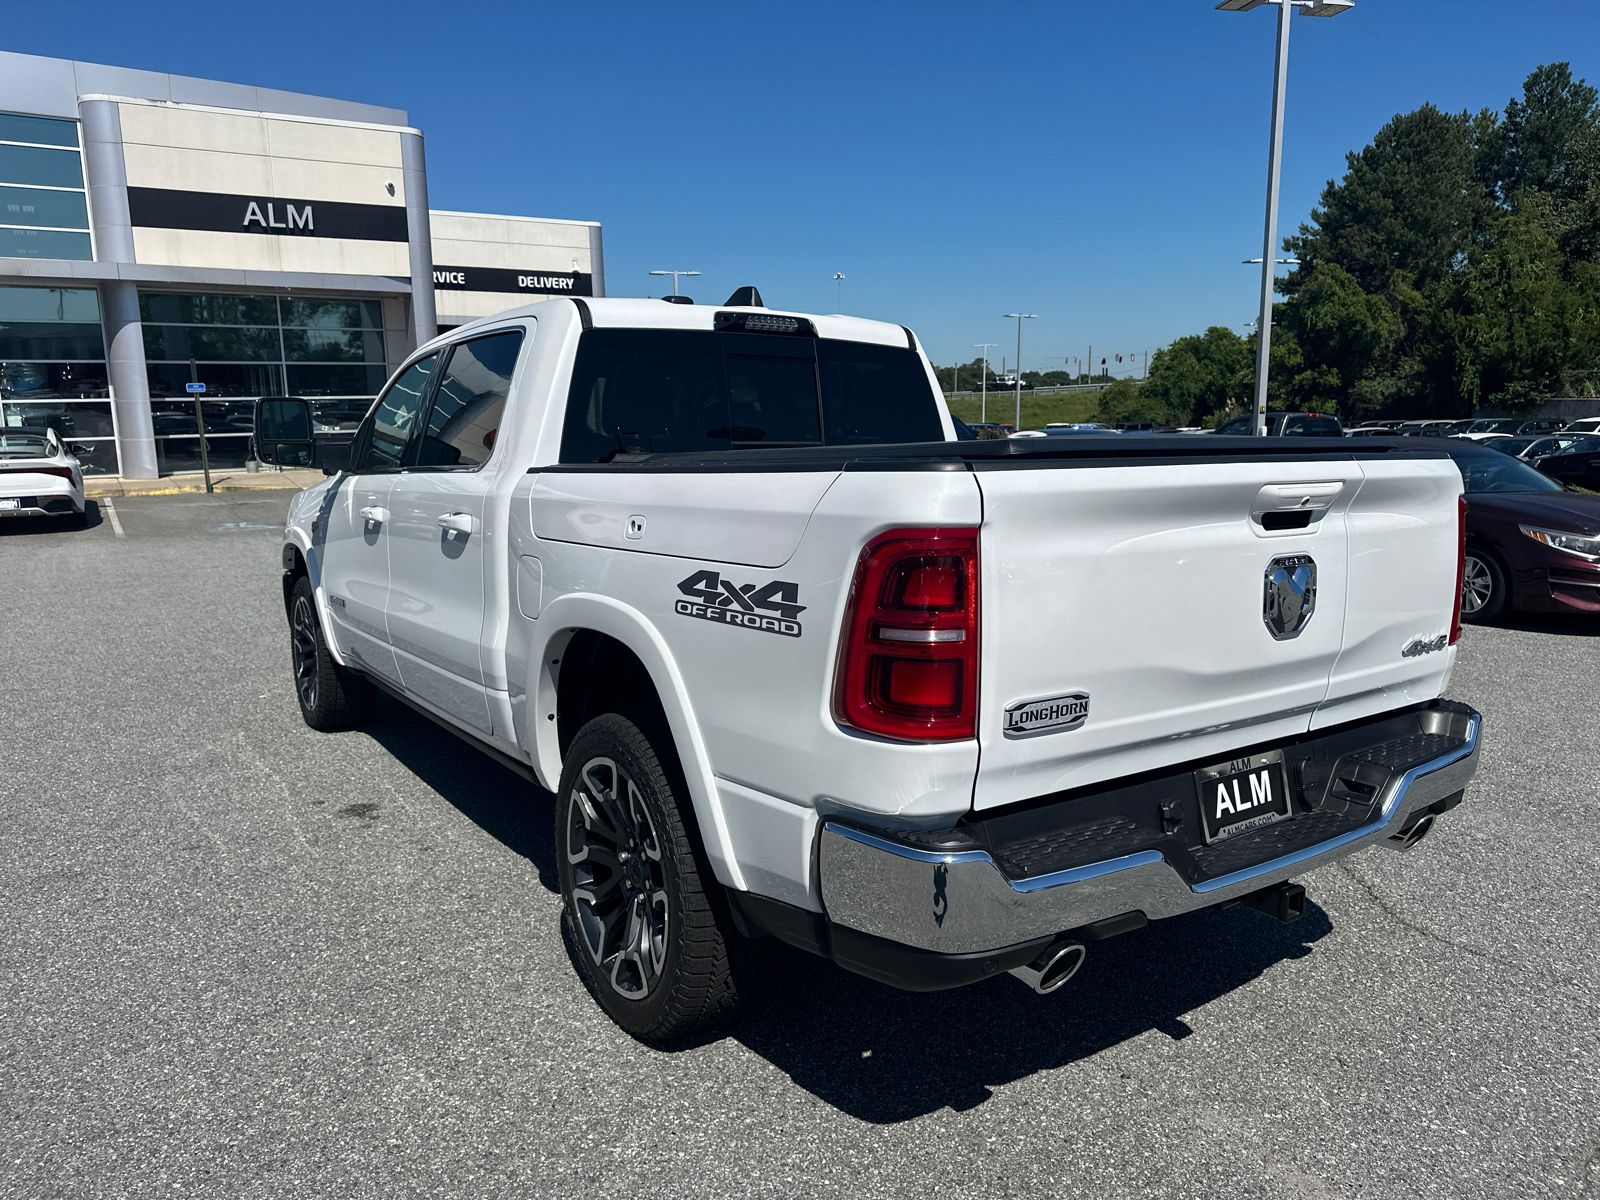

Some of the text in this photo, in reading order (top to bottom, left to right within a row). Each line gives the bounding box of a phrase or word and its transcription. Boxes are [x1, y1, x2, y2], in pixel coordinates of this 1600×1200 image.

[243, 201, 314, 230] ALM
[517, 275, 574, 290] DELIVERY
[676, 601, 800, 636] OFF ROAD
[1007, 700, 1089, 728] LONGHORN
[1229, 757, 1252, 774] ALM
[1215, 769, 1272, 819] ALM
